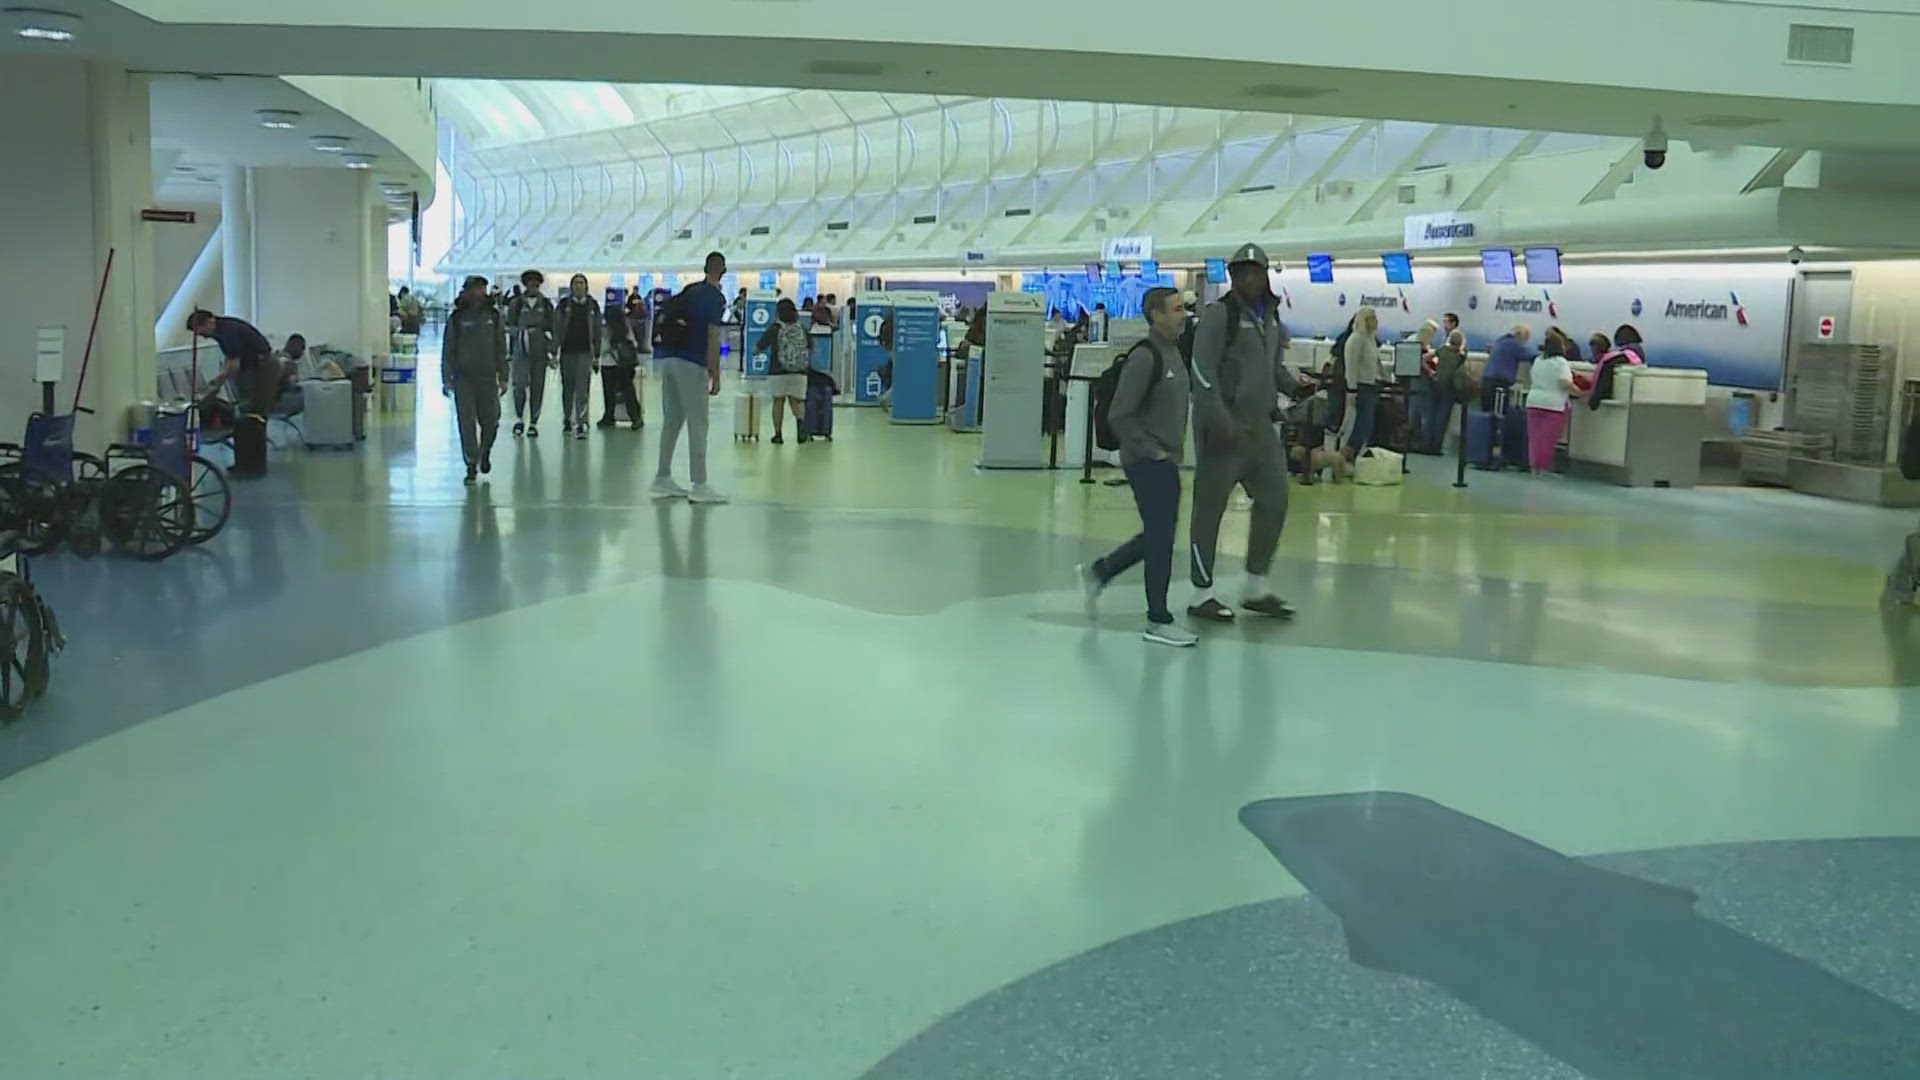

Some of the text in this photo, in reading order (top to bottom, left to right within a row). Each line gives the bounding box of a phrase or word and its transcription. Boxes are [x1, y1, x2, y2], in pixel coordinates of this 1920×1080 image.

[1424, 219, 1474, 240] American
[1359, 293, 1399, 308] American
[1495, 296, 1543, 313] American
[757, 311, 764, 321] 2
[1665, 299, 1728, 320] American
